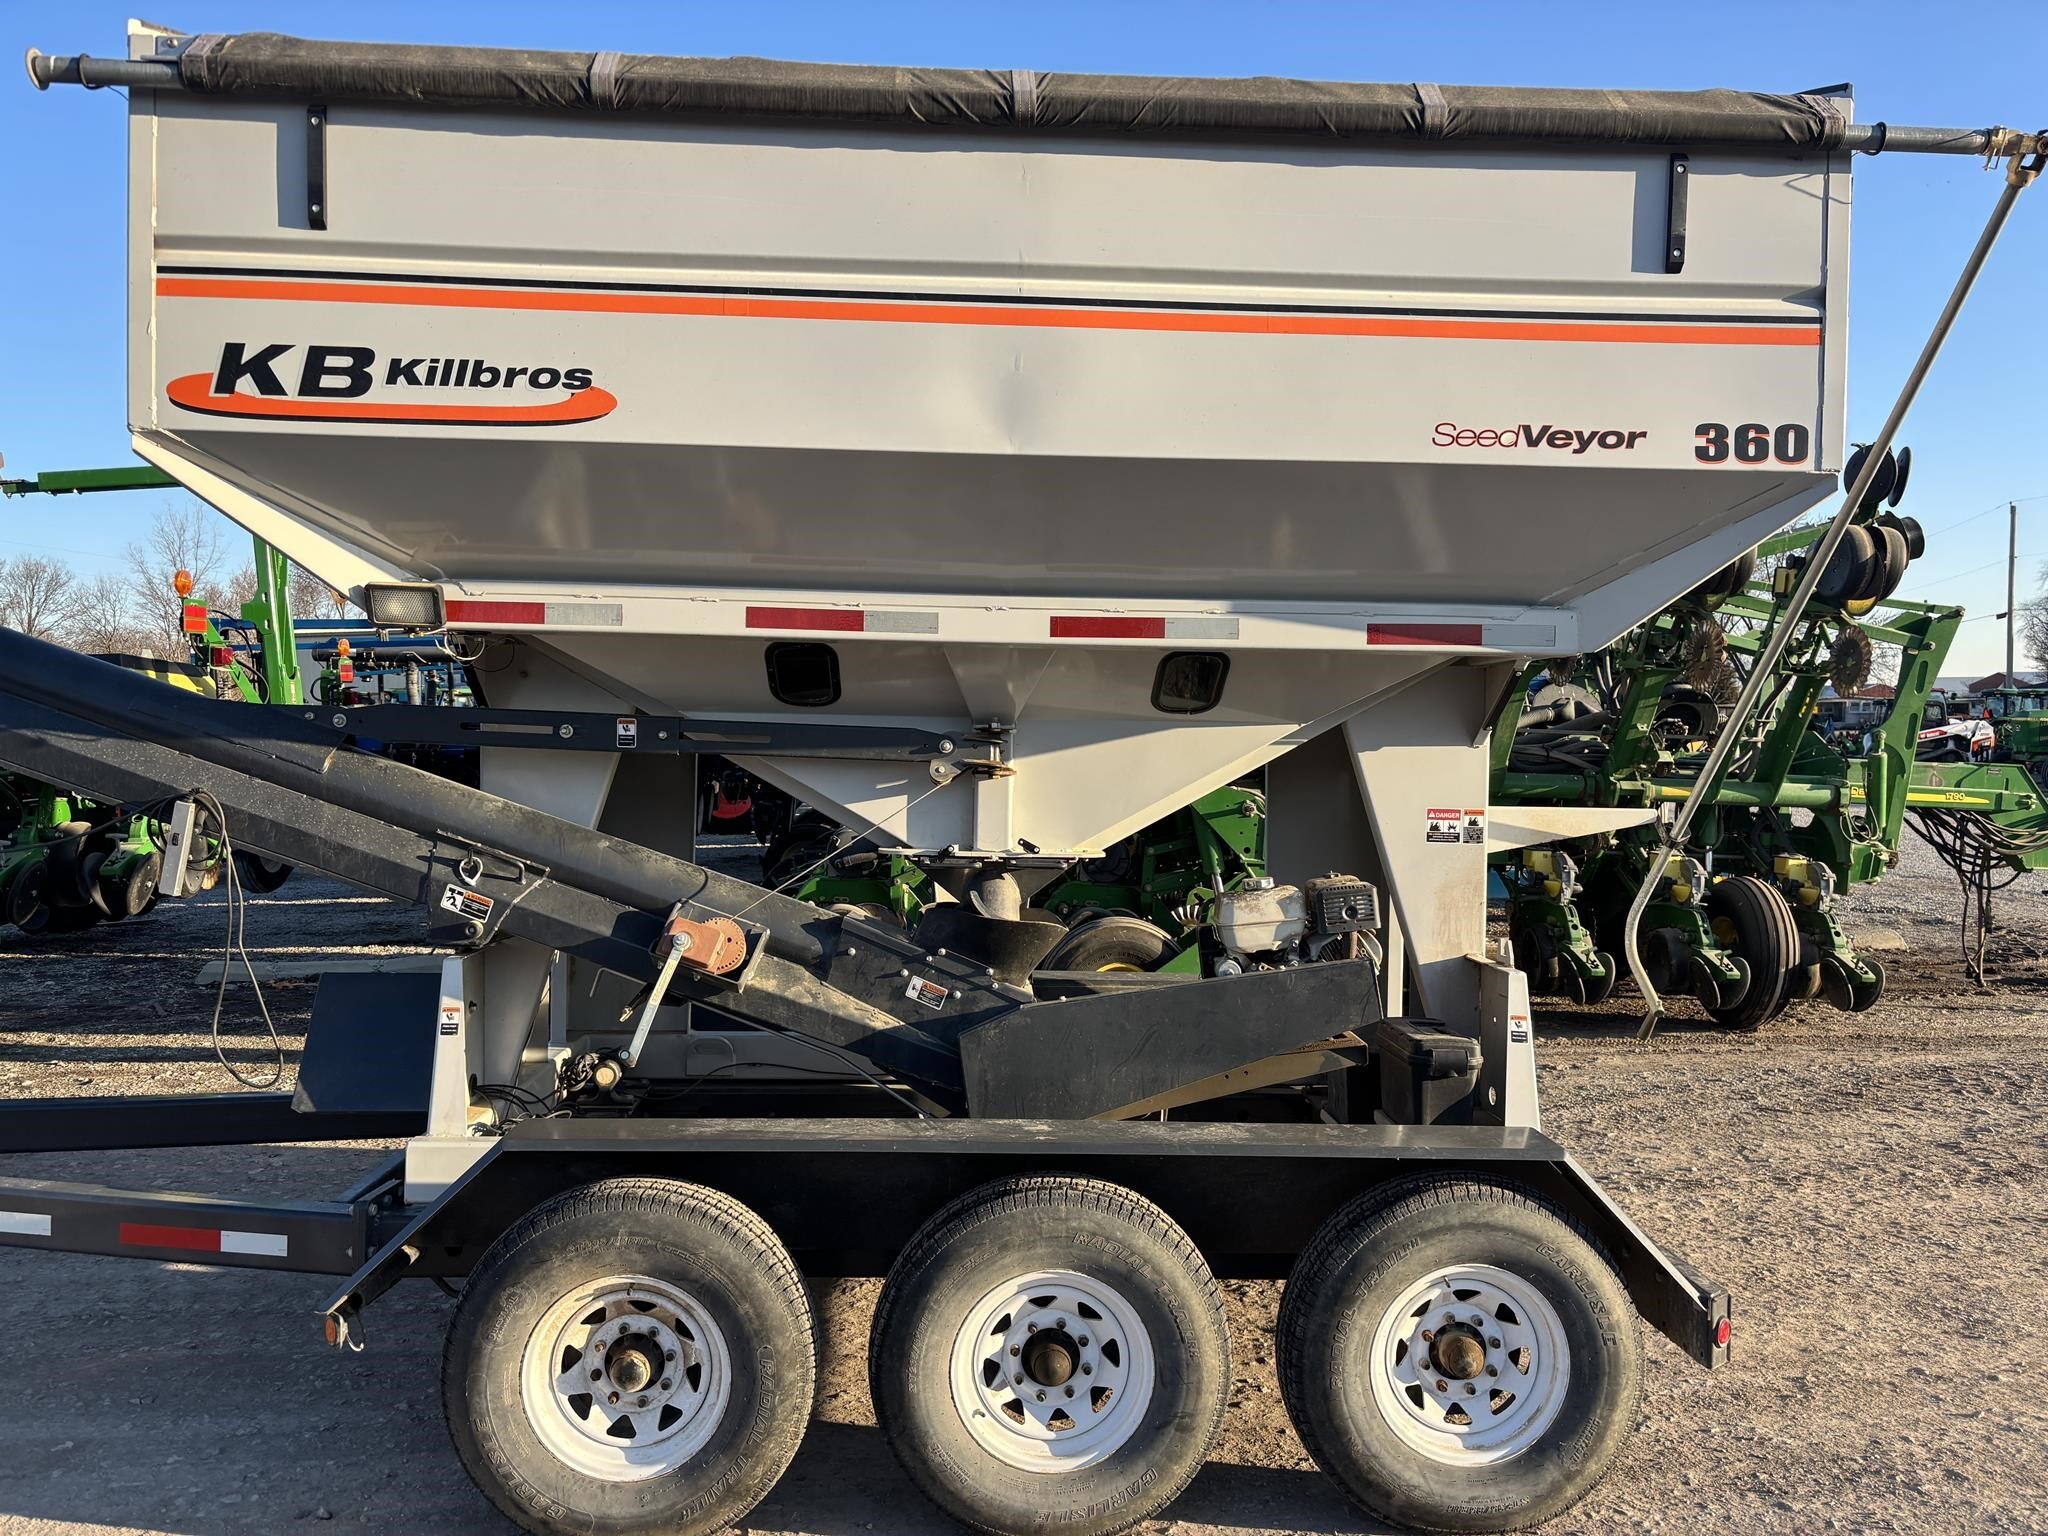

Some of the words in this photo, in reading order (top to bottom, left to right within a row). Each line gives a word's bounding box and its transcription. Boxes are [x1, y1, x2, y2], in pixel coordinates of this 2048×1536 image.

[213, 342, 376, 398] KB
[386, 357, 594, 391] Killbros
[1432, 422, 1648, 454] SeedVeyor
[1694, 423, 1809, 465] 360
[1945, 792, 1965, 800] 1790
[1072, 1232, 1152, 1279] RADIAL
[1329, 1305, 1356, 1389] RADIAL
[1353, 1249, 1409, 1299] TRAIL
[1535, 1242, 1616, 1347] CARLISLE
[746, 1358, 774, 1448] RADIAL
[472, 1414, 568, 1521] CARLISLE
[691, 1454, 749, 1510] TRAIL
[1033, 1467, 1159, 1523] CARLISLE
